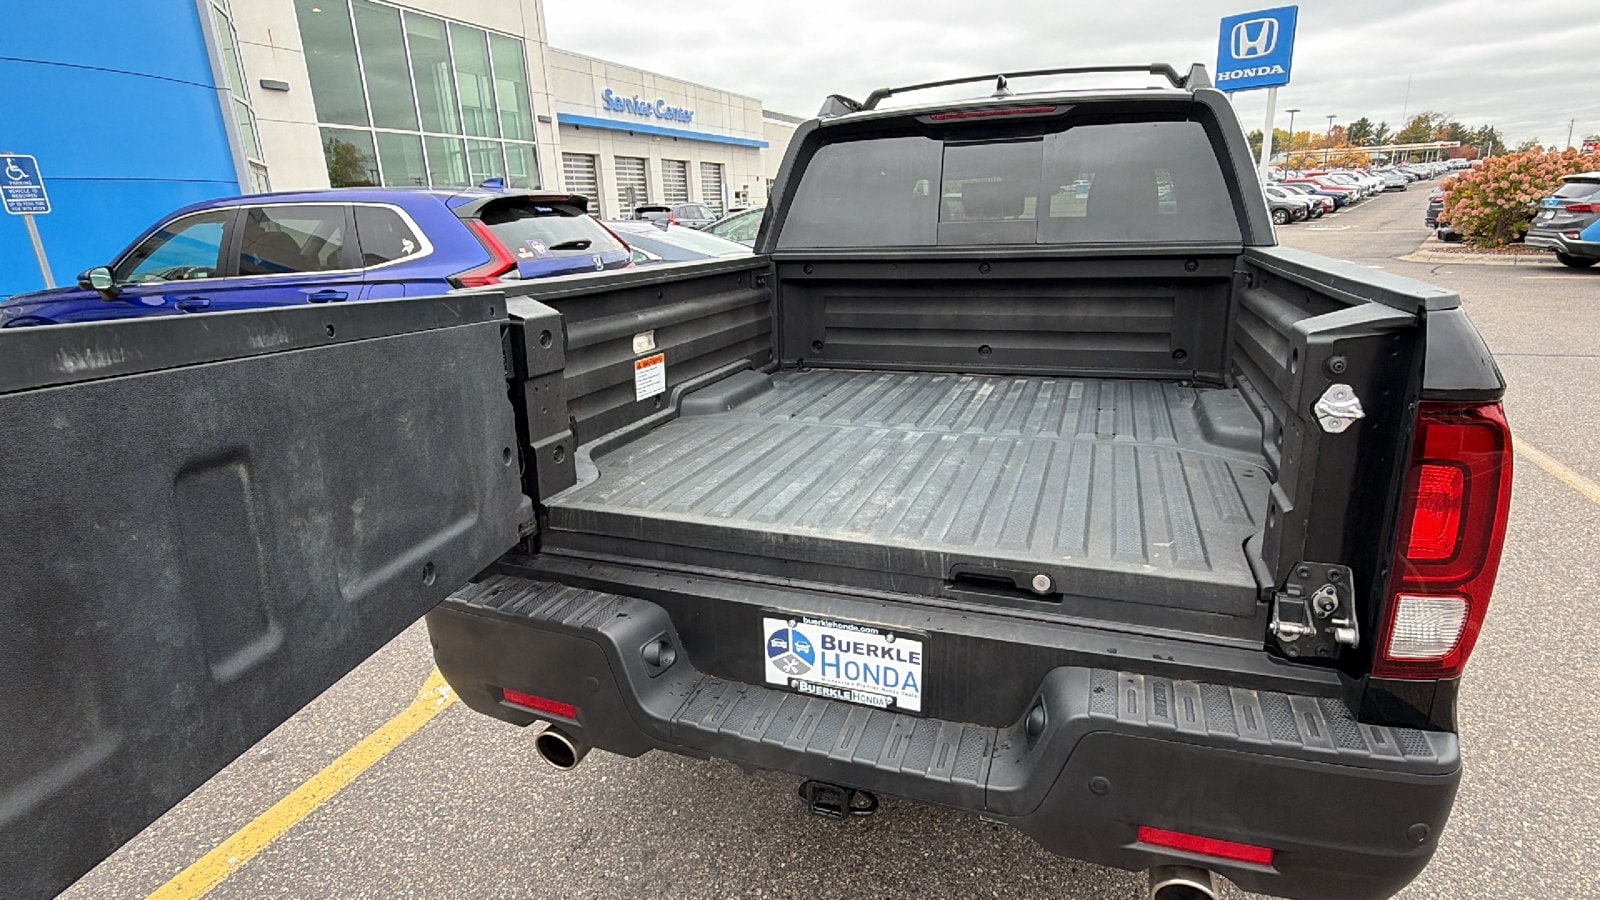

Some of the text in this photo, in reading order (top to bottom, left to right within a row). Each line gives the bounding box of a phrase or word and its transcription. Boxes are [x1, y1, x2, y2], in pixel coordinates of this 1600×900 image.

[1217, 64, 1285, 81] HONDA
[601, 88, 694, 123] Service Center
[802, 616, 879, 635] buerklehonda.com
[821, 634, 920, 665] BUERKLE
[821, 651, 919, 693] HONDA
[799, 680, 887, 706] BUERKLE HONDA
